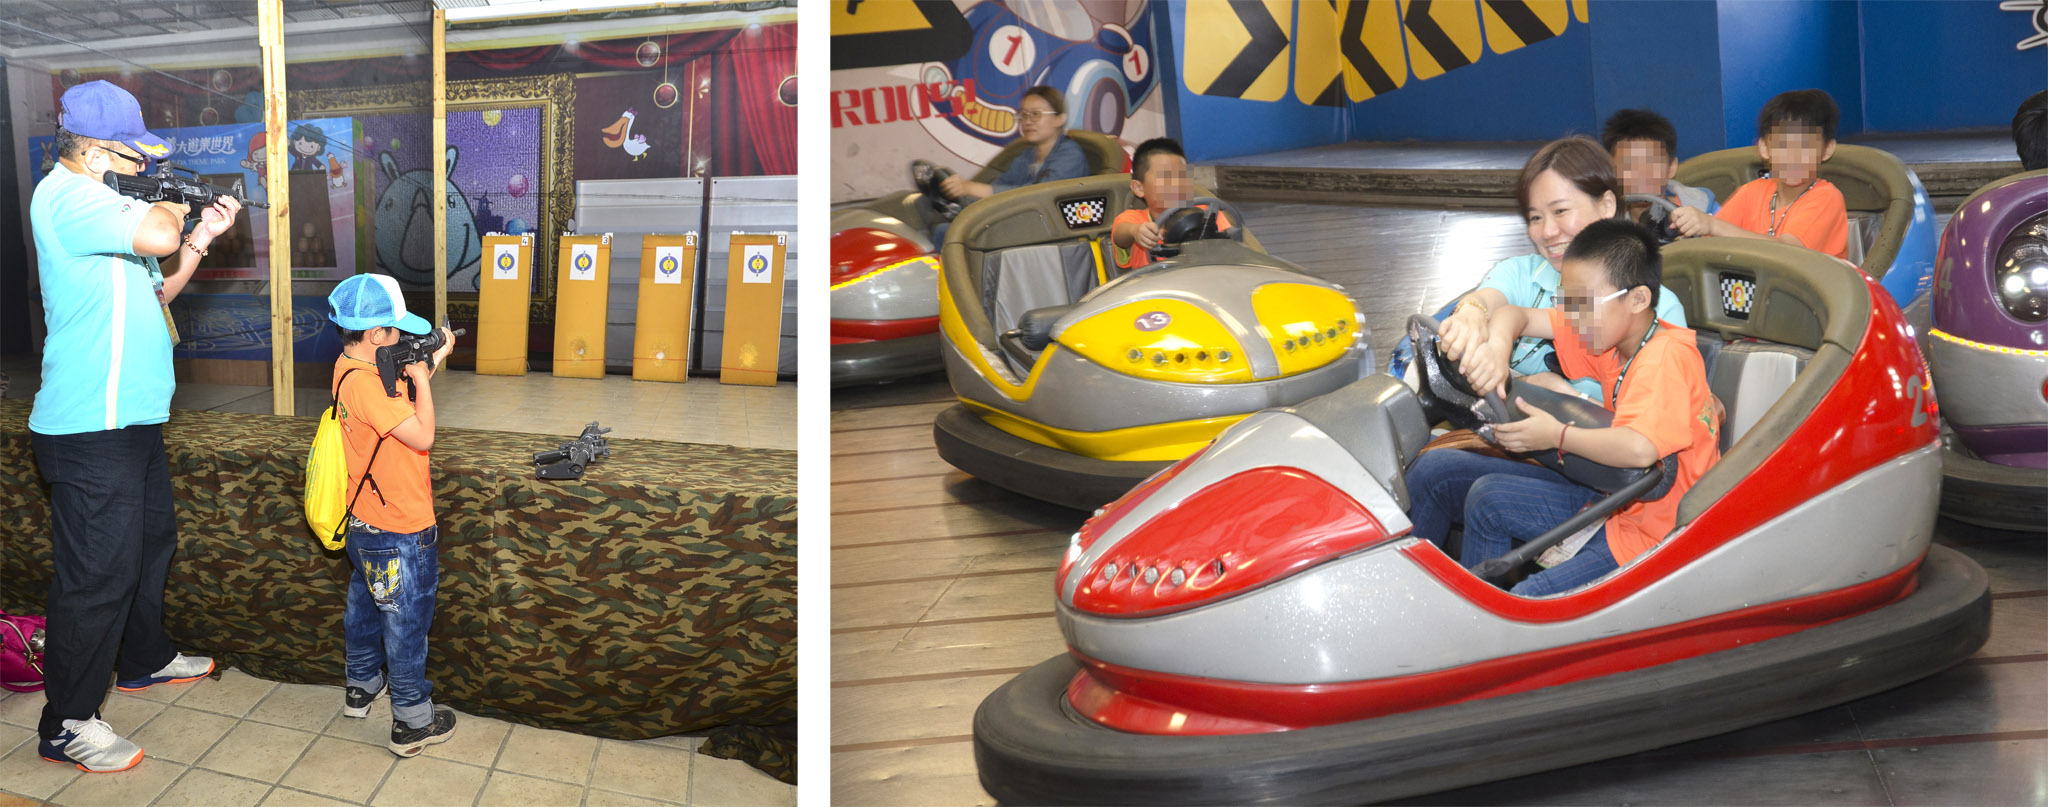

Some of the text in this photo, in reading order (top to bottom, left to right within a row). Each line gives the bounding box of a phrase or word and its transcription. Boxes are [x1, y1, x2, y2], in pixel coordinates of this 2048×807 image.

[1002, 34, 1022, 67] 1
[1128, 50, 1142, 76] 1
[1078, 207, 1089, 217] 14
[522, 236, 528, 245] 4
[602, 236, 609, 244] 3
[687, 236, 693, 245] 2
[779, 236, 784, 245] 1
[1735, 288, 1742, 302] 2
[1137, 313, 1168, 329] 13
